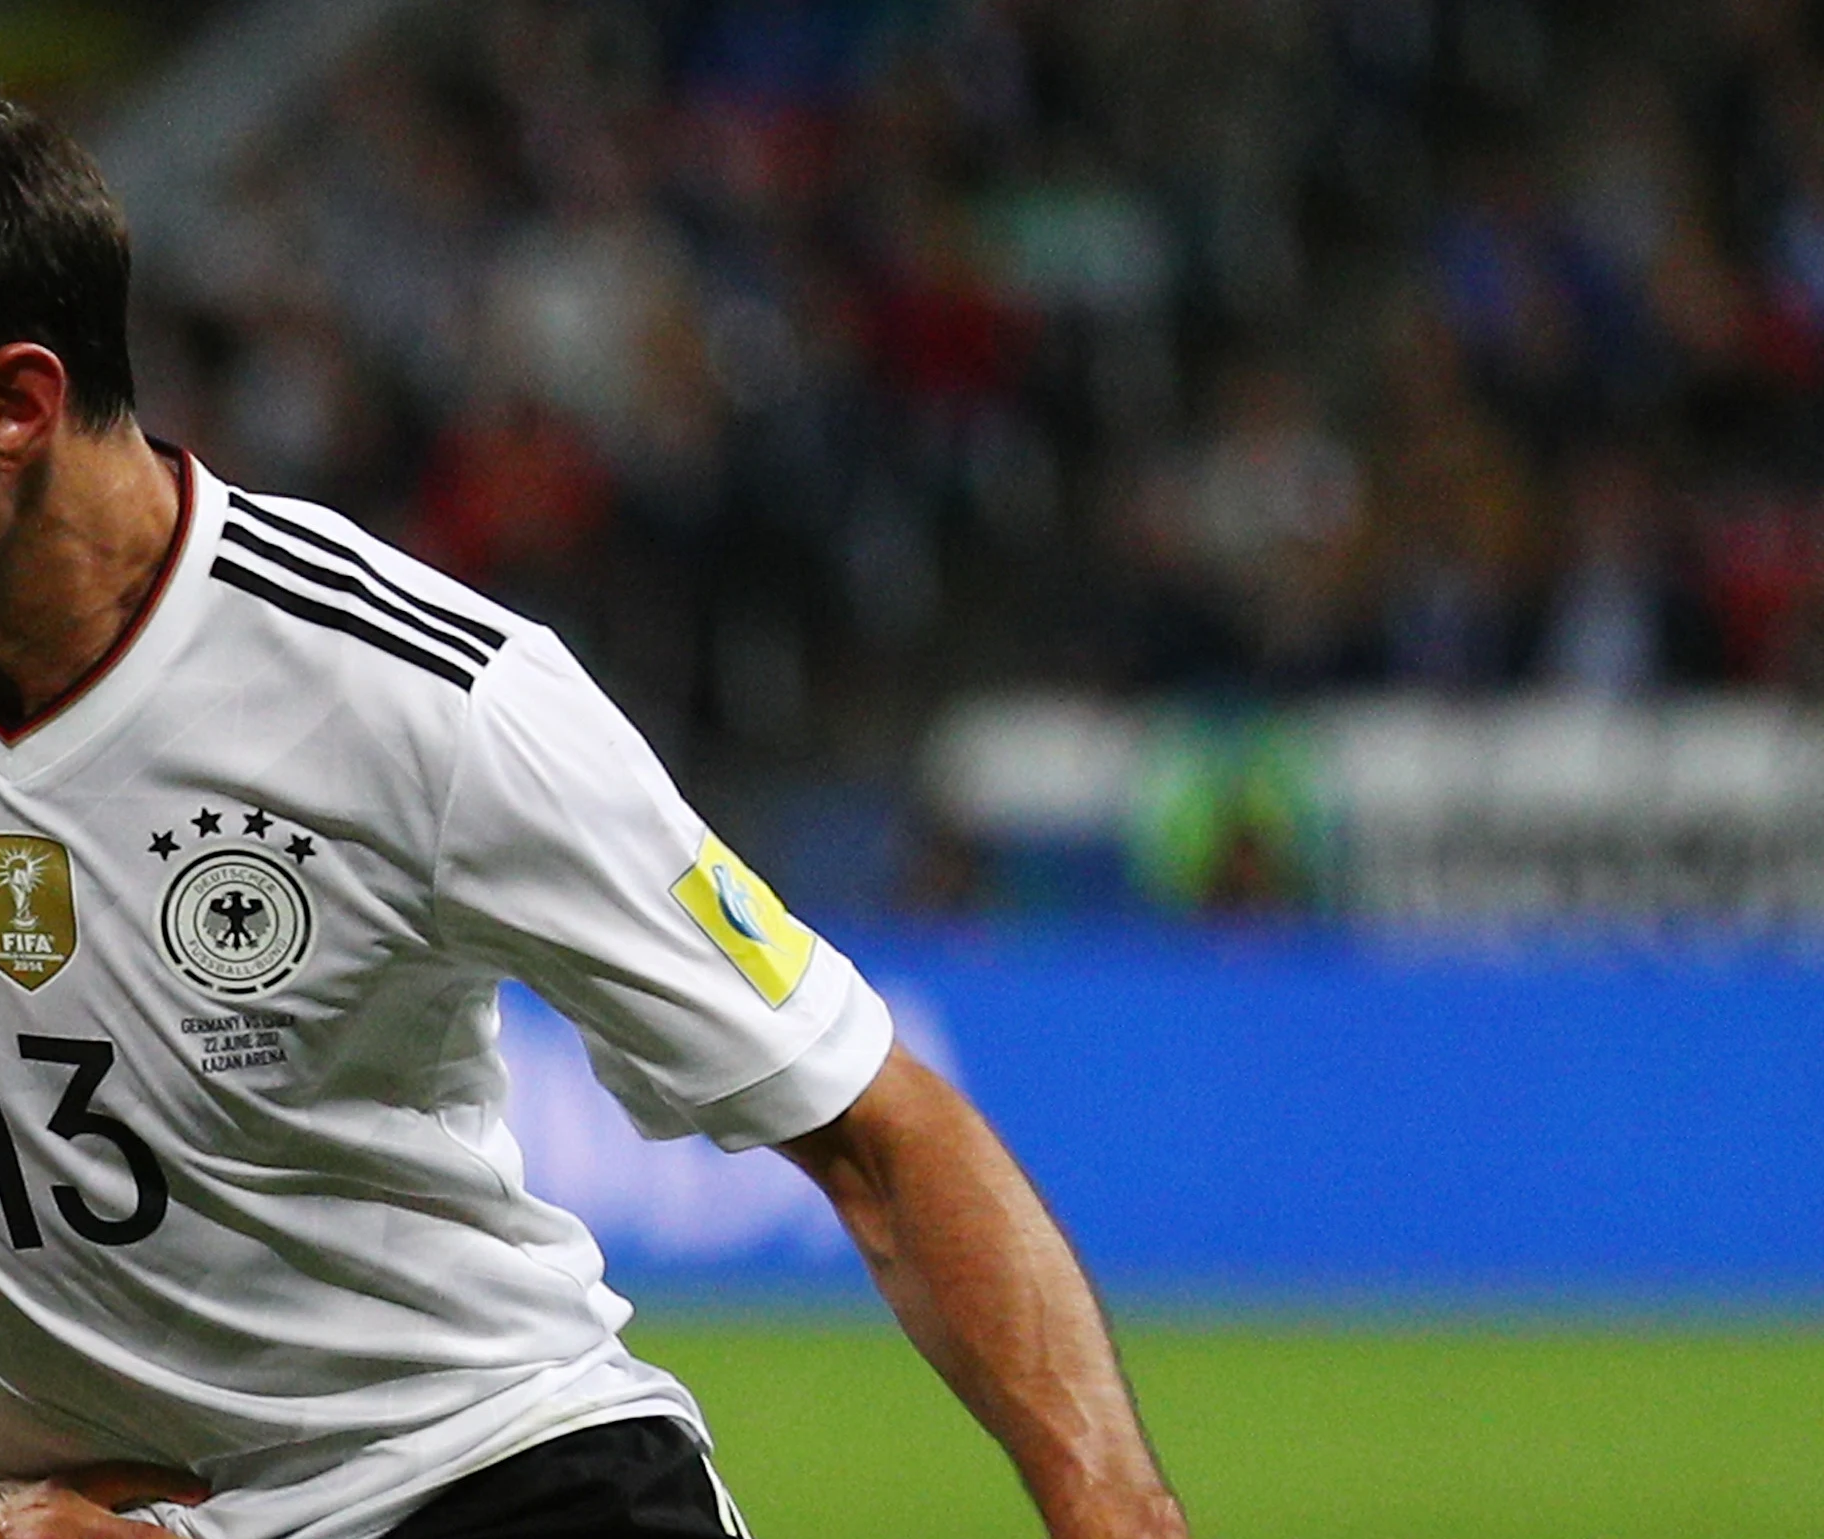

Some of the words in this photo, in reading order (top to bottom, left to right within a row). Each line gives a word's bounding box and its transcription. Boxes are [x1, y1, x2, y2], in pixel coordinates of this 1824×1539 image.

[193, 867, 277, 895] DEUTSCHER
[2, 932, 52, 953] FIFA
[181, 1015, 239, 1034] GERMANY
